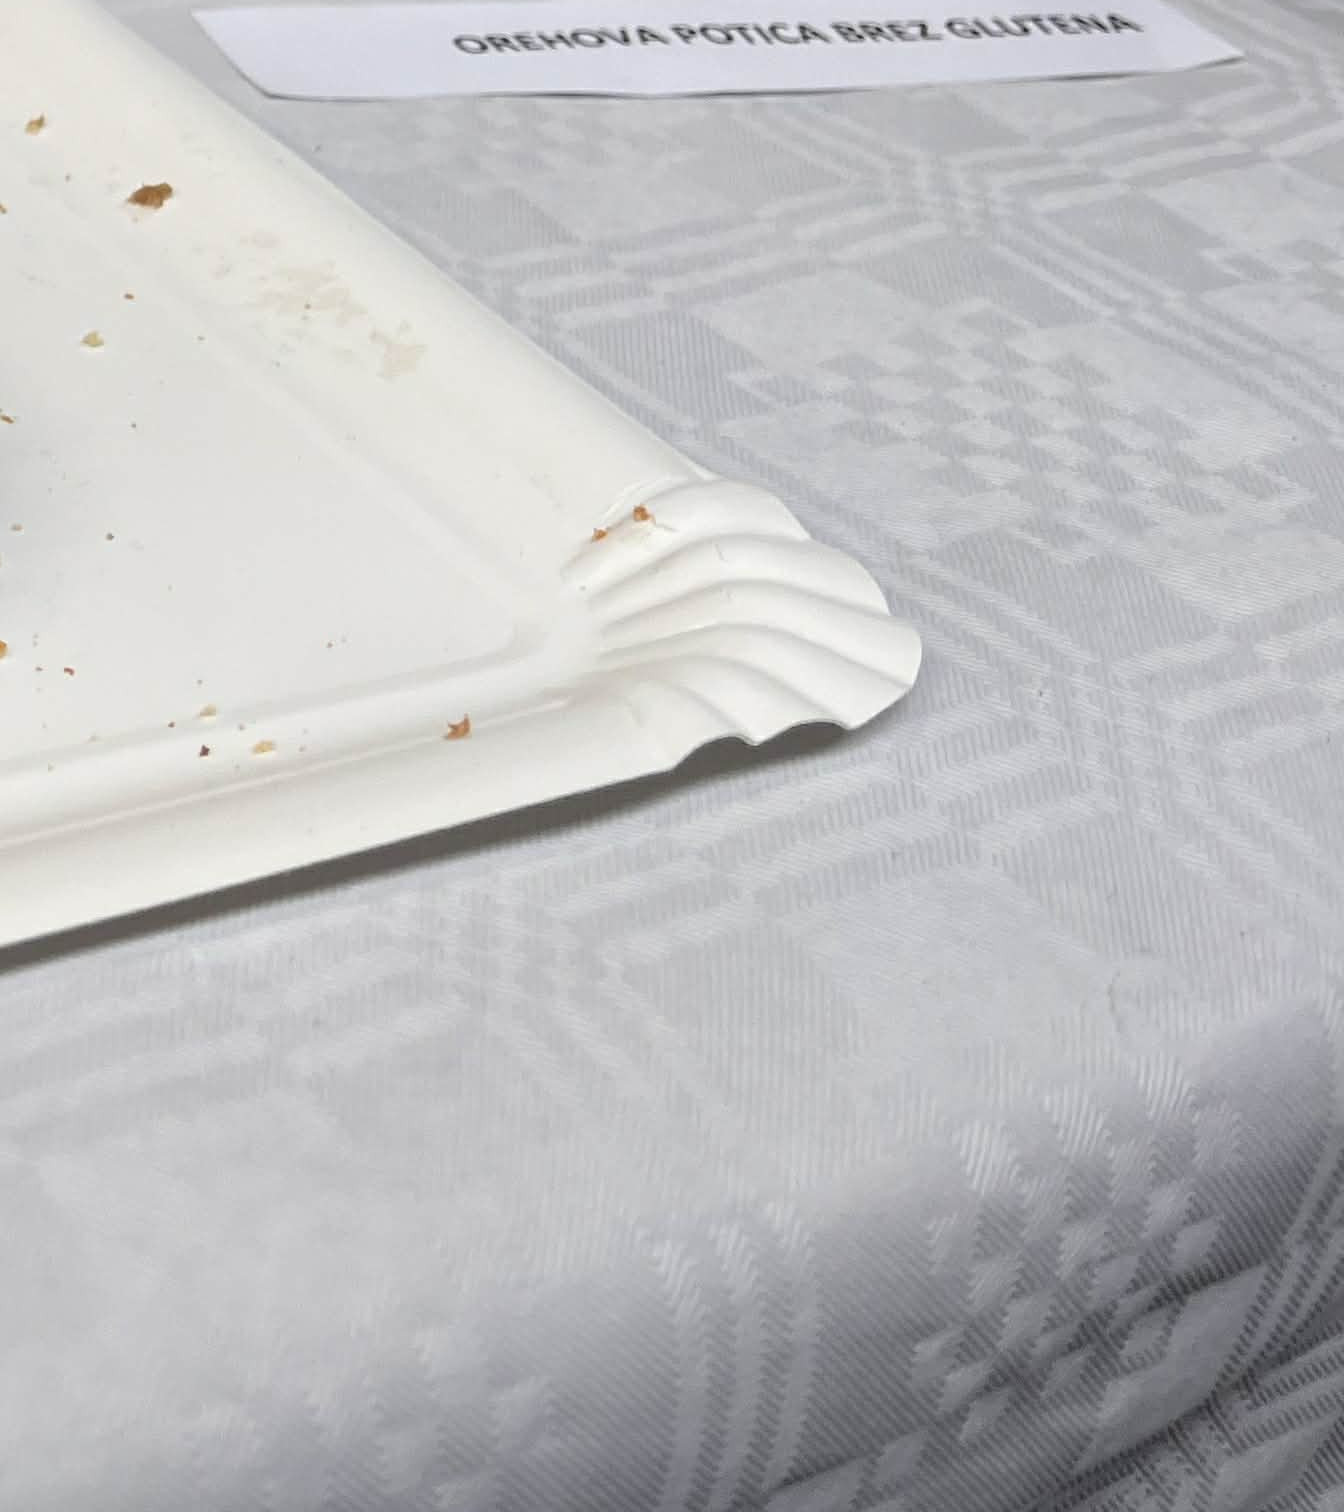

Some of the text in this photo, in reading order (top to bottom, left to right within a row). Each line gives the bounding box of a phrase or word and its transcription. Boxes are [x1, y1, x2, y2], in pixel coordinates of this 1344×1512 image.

[451, 10, 1144, 56] OREHOVA POTICA BREZ GLUTENA
